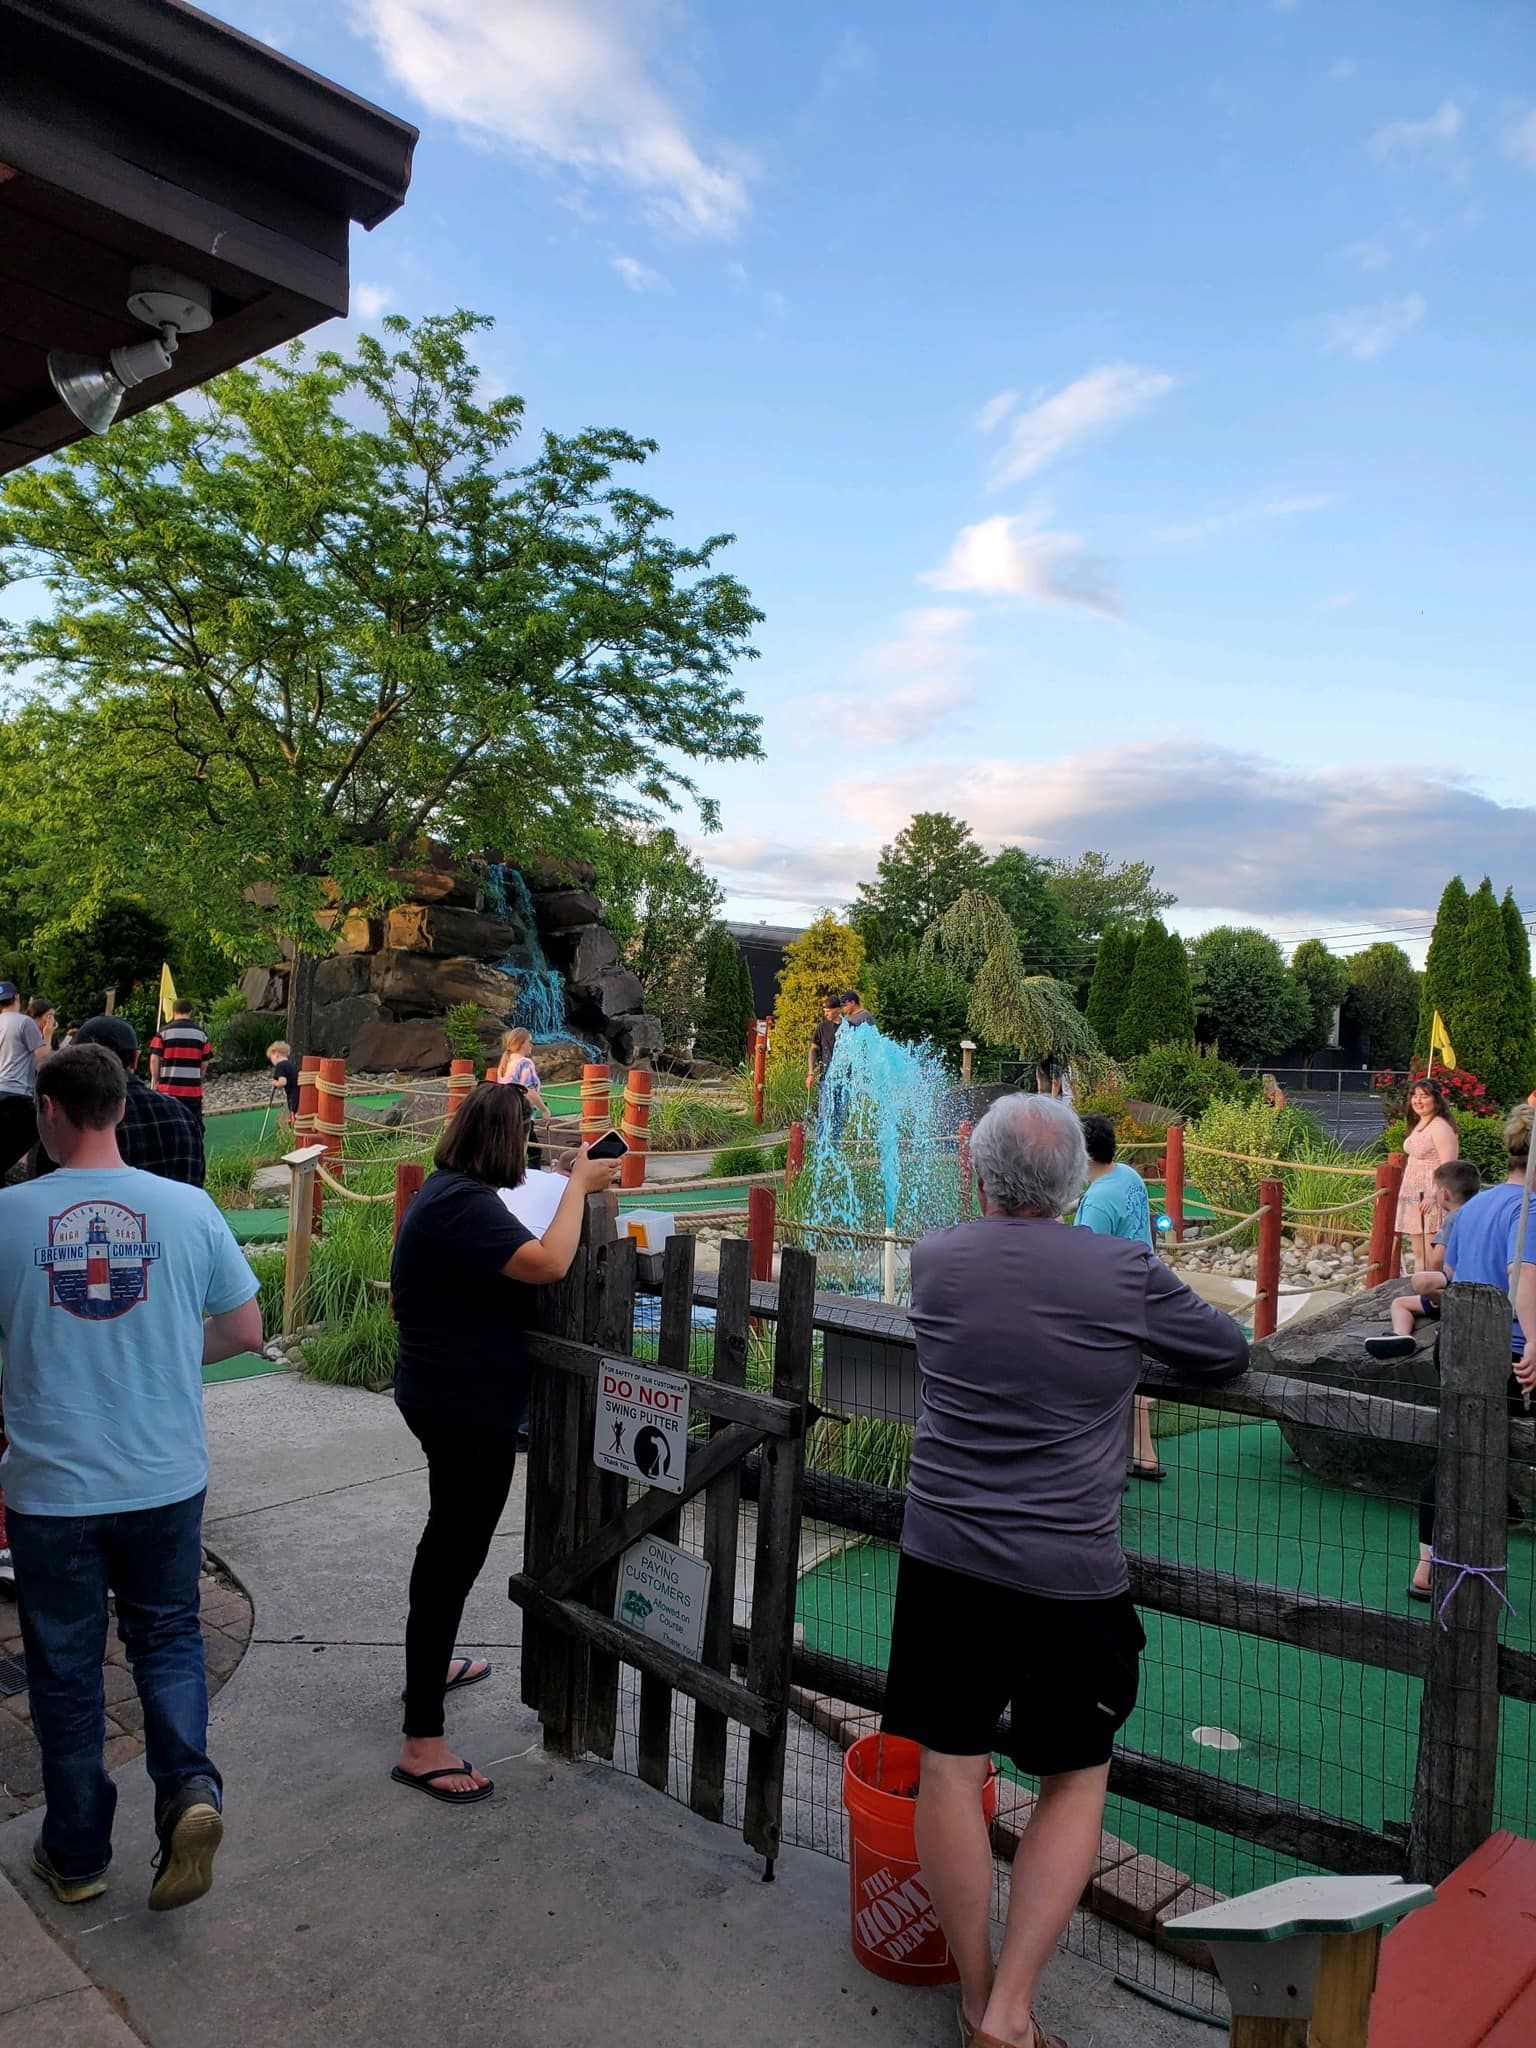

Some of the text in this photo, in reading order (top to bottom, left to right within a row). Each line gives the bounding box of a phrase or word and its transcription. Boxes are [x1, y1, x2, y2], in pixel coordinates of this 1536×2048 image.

[115, 1229, 136, 1240] SEAS
[40, 1244, 157, 1262] BREWING COMPANY
[604, 1365, 685, 1393] FOR SAFETY OF OUR CUSTOMERS
[603, 1375, 683, 1413] DO NOT
[605, 1400, 679, 1433] SWING PUTTER
[603, 1456, 630, 1471] Thank You
[648, 1545, 677, 1566] ONLY
[641, 1556, 679, 1585] PAYING
[625, 1564, 691, 1608] CUSTOMERS
[659, 1613, 684, 1634] Course
[681, 1614, 690, 1625] on
[861, 1867, 898, 1901] THE
[855, 1876, 934, 1949] HOM
[884, 1908, 941, 1961] DEPO
